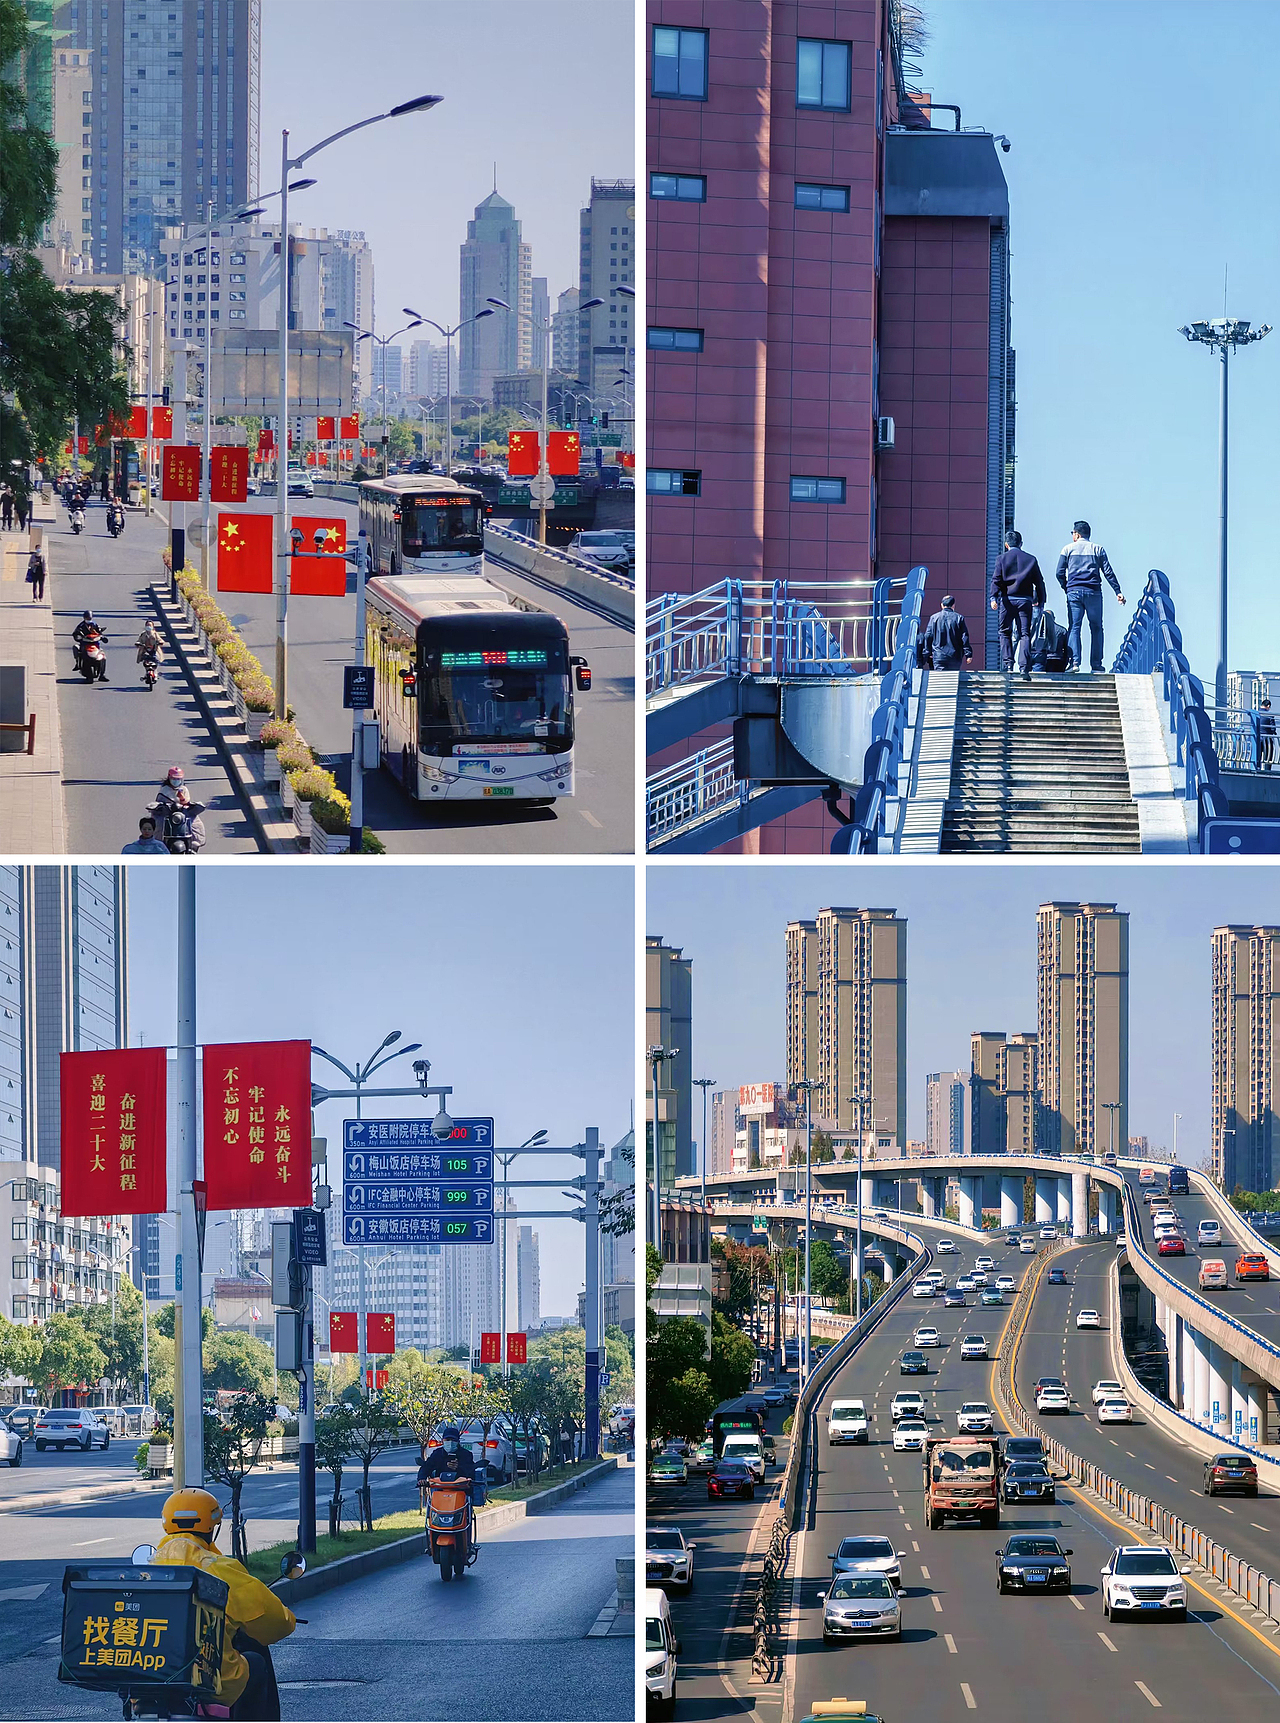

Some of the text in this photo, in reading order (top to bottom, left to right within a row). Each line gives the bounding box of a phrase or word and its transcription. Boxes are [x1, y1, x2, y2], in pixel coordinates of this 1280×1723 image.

[222, 1066, 240, 1145] 不忘初心
[89, 1074, 107, 1173] 喜迎二十大
[248, 1085, 266, 1165] 牢记使命
[119, 1093, 138, 1192] 奋进新征程
[274, 1105, 292, 1185] 永远奋斗
[368, 1155, 440, 1171] 梅山饭店停车场
[447, 1159, 468, 1170] 105
[409, 1170, 430, 1178] Parking
[368, 1187, 440, 1202] IFC金融中心停车场
[447, 1191, 467, 1202] 999
[368, 1219, 440, 1234] 安徽饭店停车场
[447, 1223, 467, 1234] 057
[125, 1602, 141, 1611] 美团
[83, 1616, 169, 1647] 找餐厅
[79, 1647, 166, 1671] 上美团App
